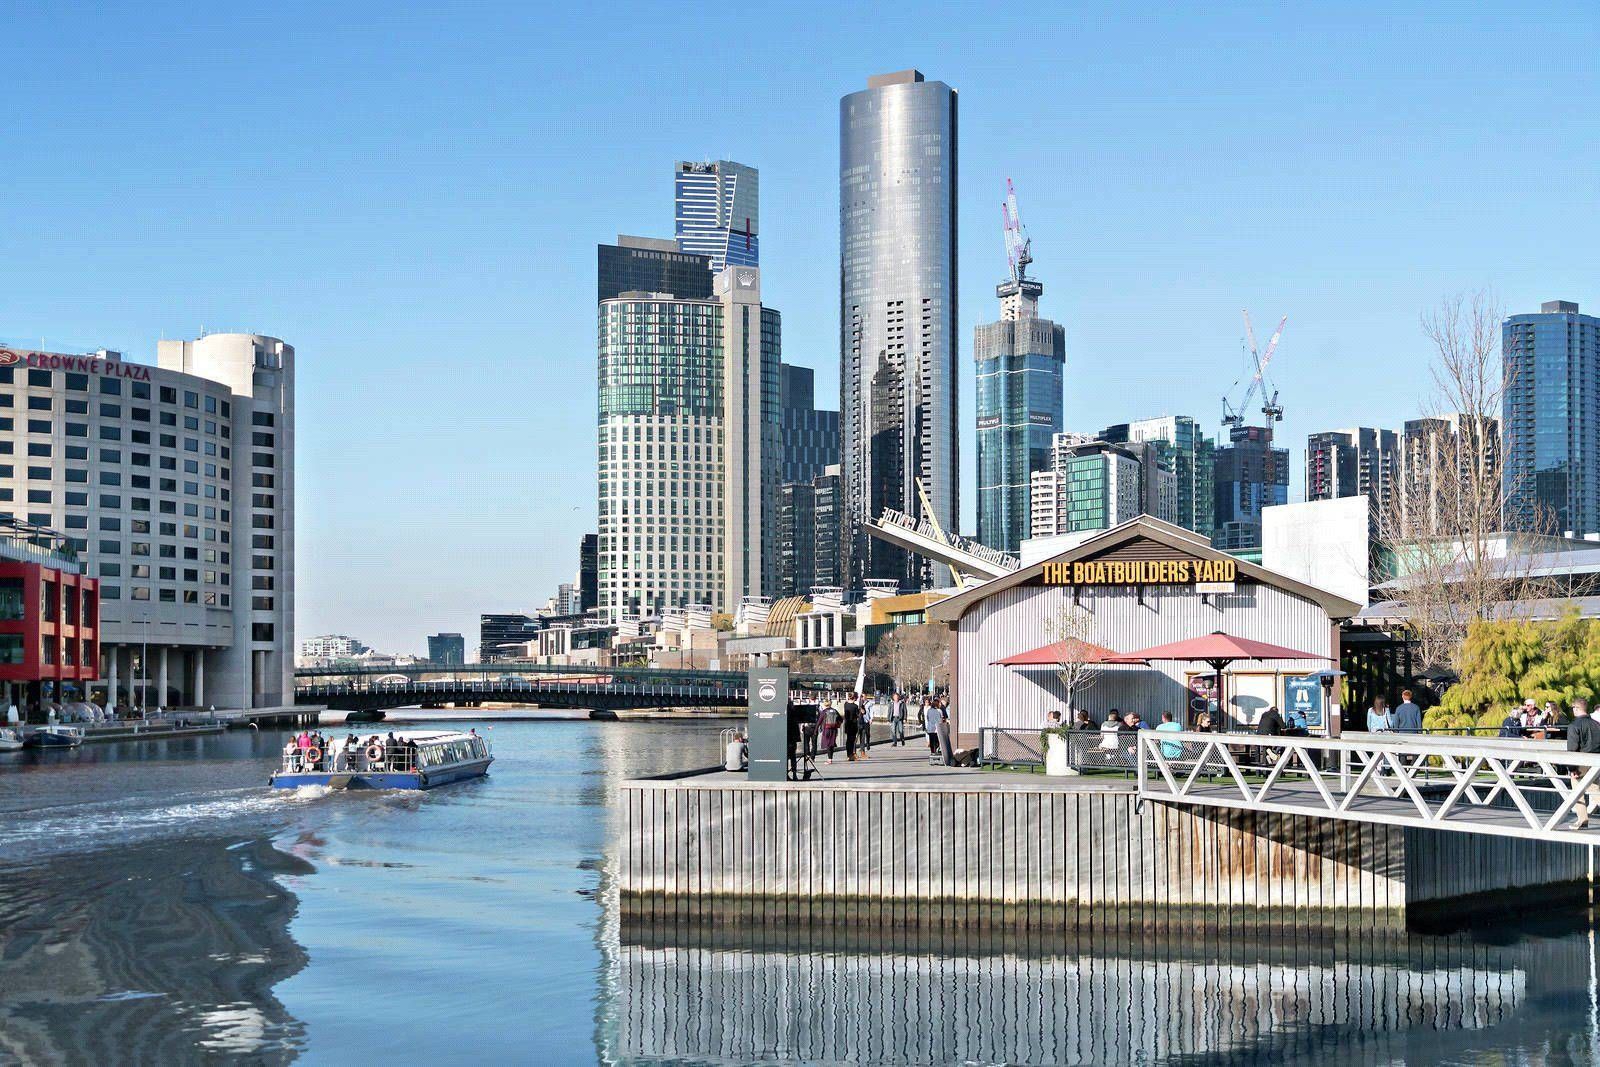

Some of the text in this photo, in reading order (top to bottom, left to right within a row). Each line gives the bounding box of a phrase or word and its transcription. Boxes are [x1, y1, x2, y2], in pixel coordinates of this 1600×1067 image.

[26, 352, 151, 381] CROWNE PLAZA
[1042, 560, 1236, 584] THE BOATBUILDERS YARD
